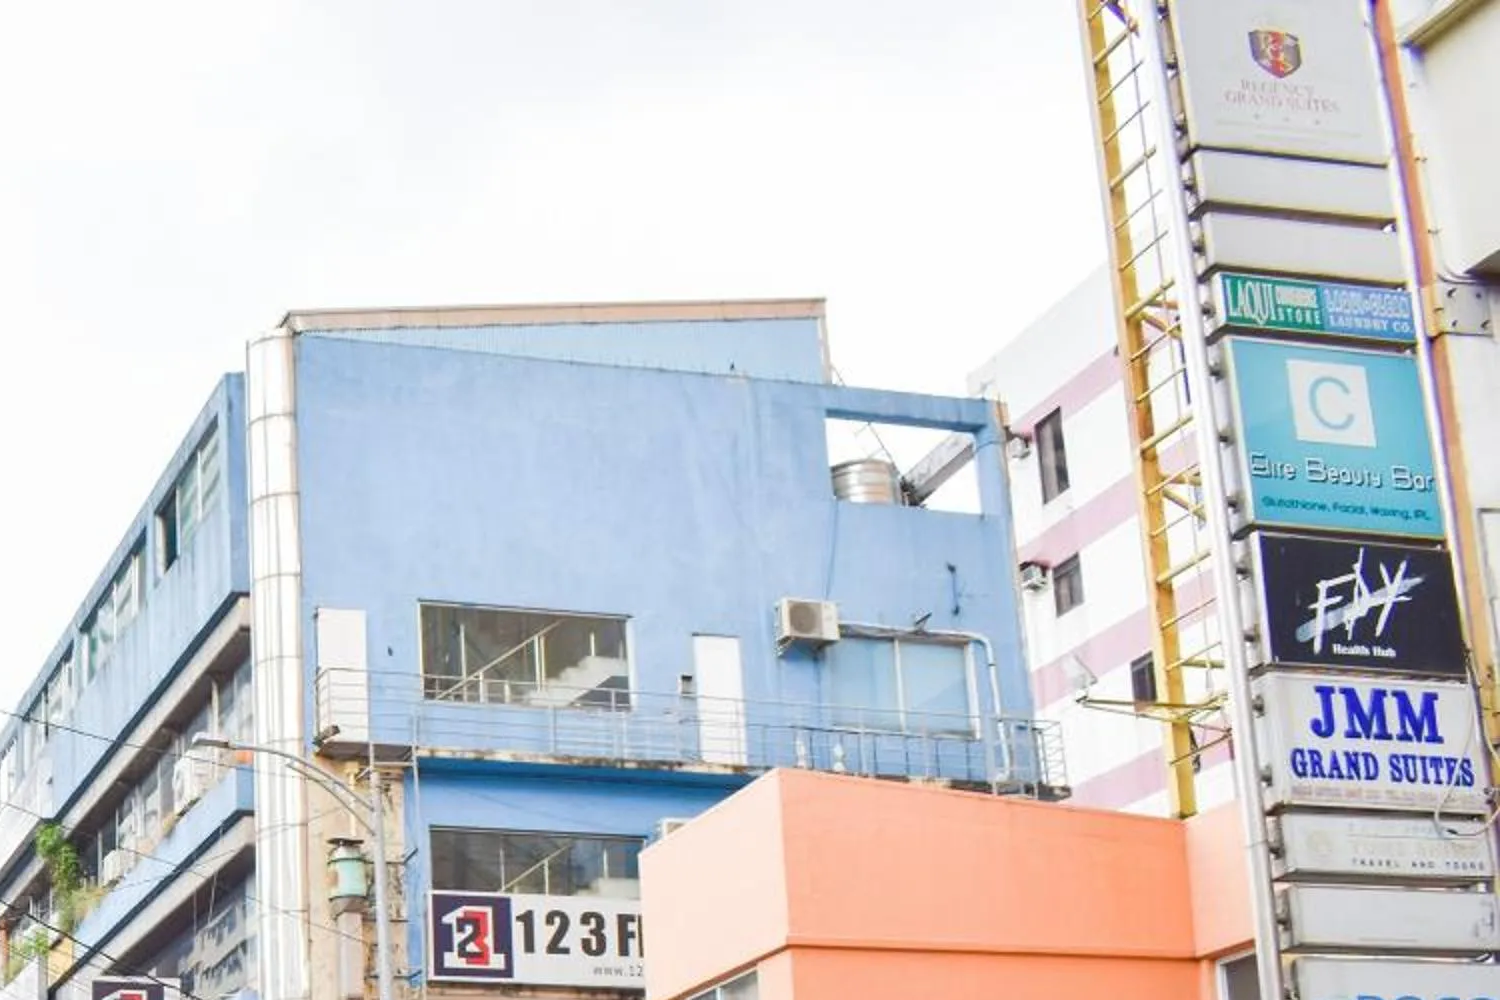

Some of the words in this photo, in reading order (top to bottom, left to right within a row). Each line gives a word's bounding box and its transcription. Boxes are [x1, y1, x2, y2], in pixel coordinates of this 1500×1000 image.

[1309, 376, 1355, 430] C
[1305, 458, 1383, 489] Beauty
[1391, 466, 1436, 493] Bar
[1310, 685, 1443, 744] JMM
[1291, 747, 1379, 781] GRAND
[1389, 753, 1475, 787] SUITES
